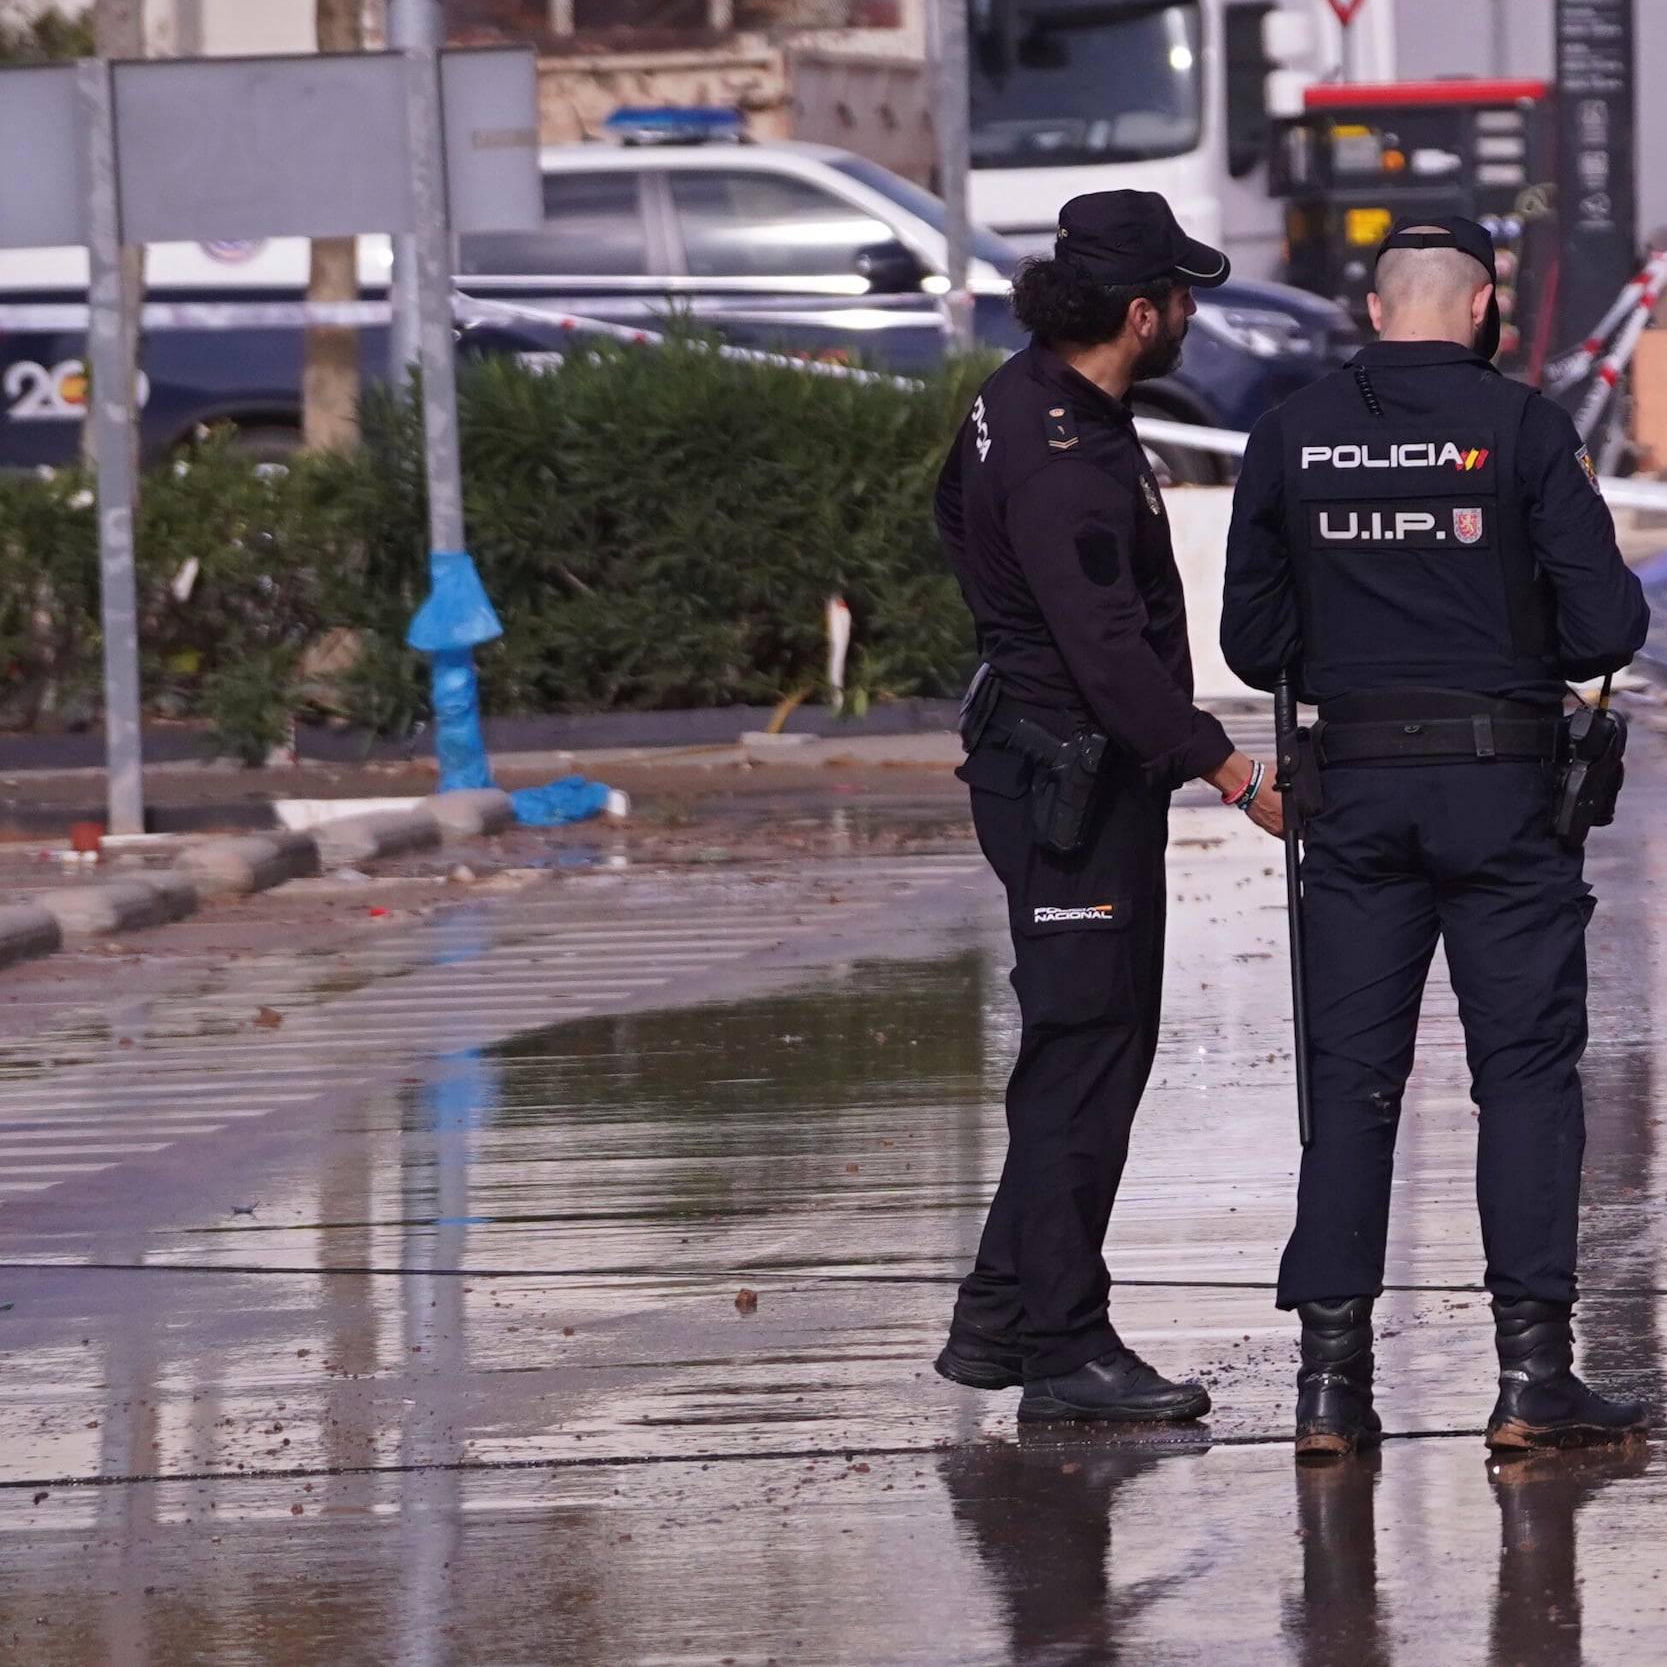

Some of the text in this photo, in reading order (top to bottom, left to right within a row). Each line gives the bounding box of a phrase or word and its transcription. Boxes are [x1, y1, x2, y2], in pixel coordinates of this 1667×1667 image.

[1301, 441, 1464, 470] POLICIA
[1319, 512, 1447, 541] U.I.P.
[1034, 911, 1113, 924] NACIONAL
